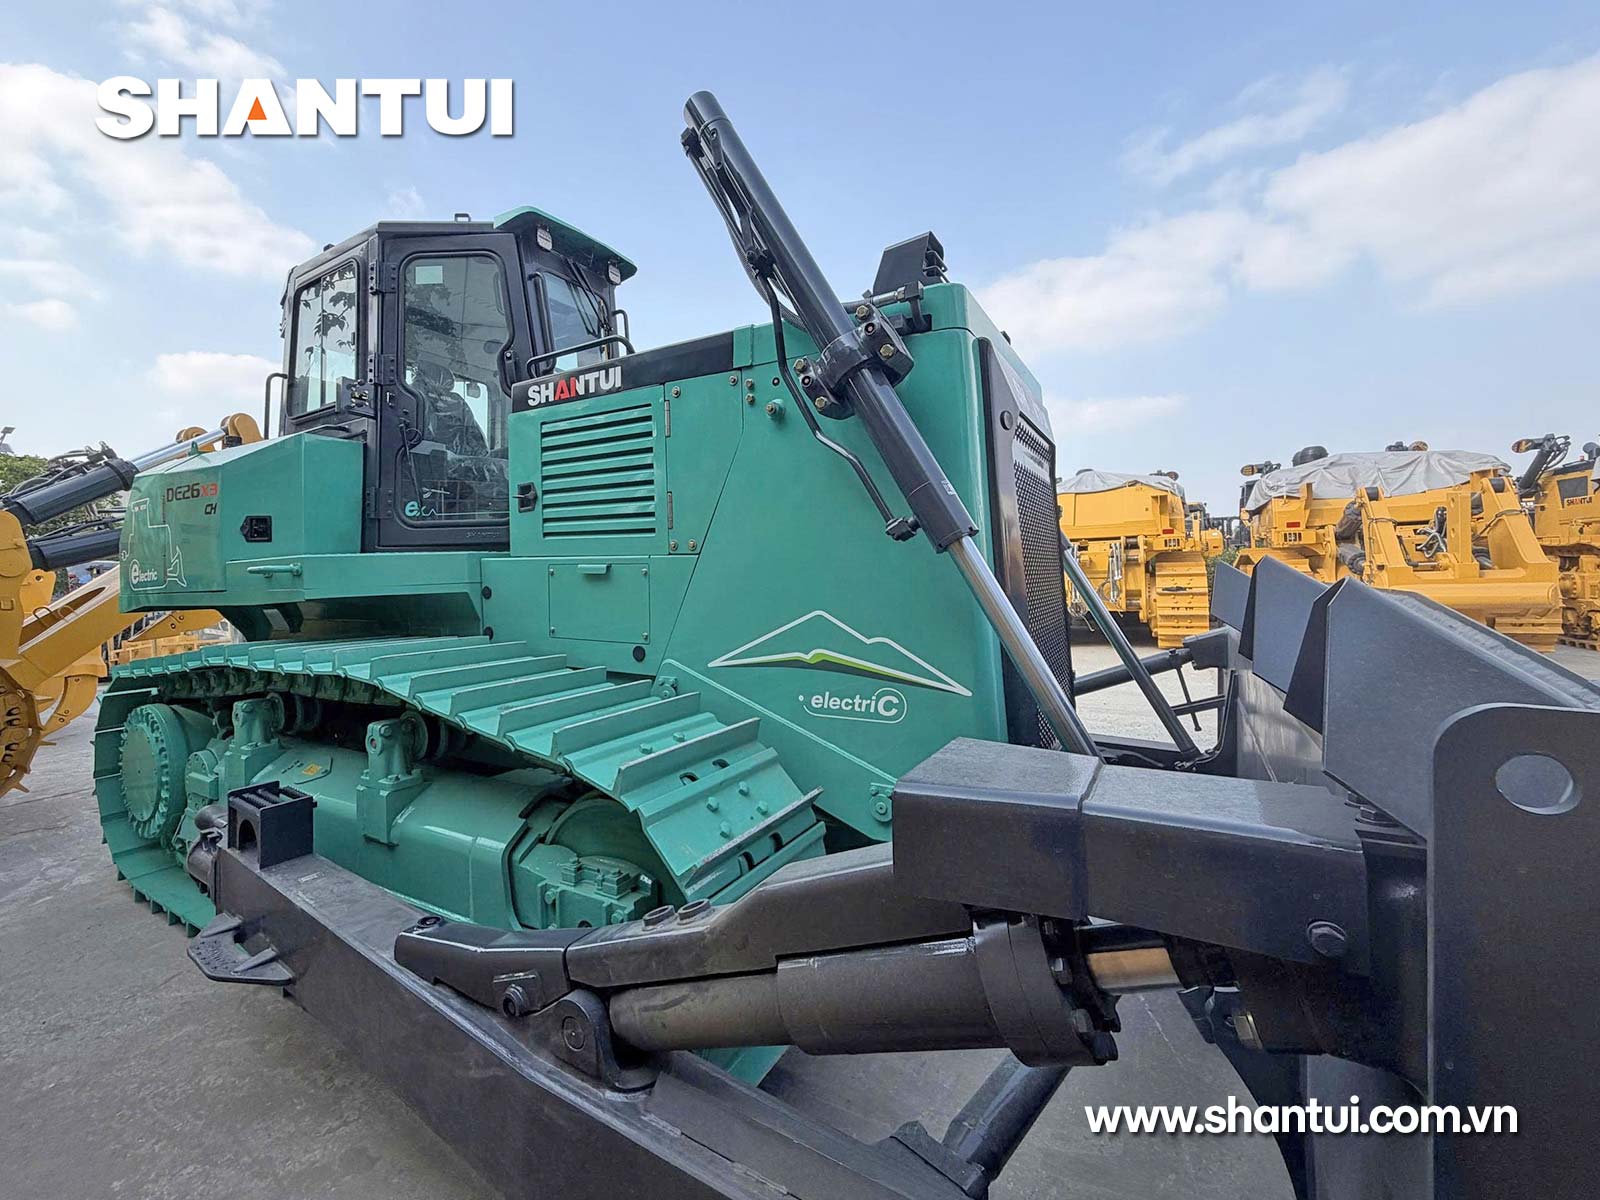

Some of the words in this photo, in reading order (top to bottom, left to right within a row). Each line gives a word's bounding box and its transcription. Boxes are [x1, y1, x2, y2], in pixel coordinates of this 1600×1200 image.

[527, 366, 622, 407] SHANTUI
[166, 482, 218, 502] DE26X3
[131, 564, 157, 584] electric
